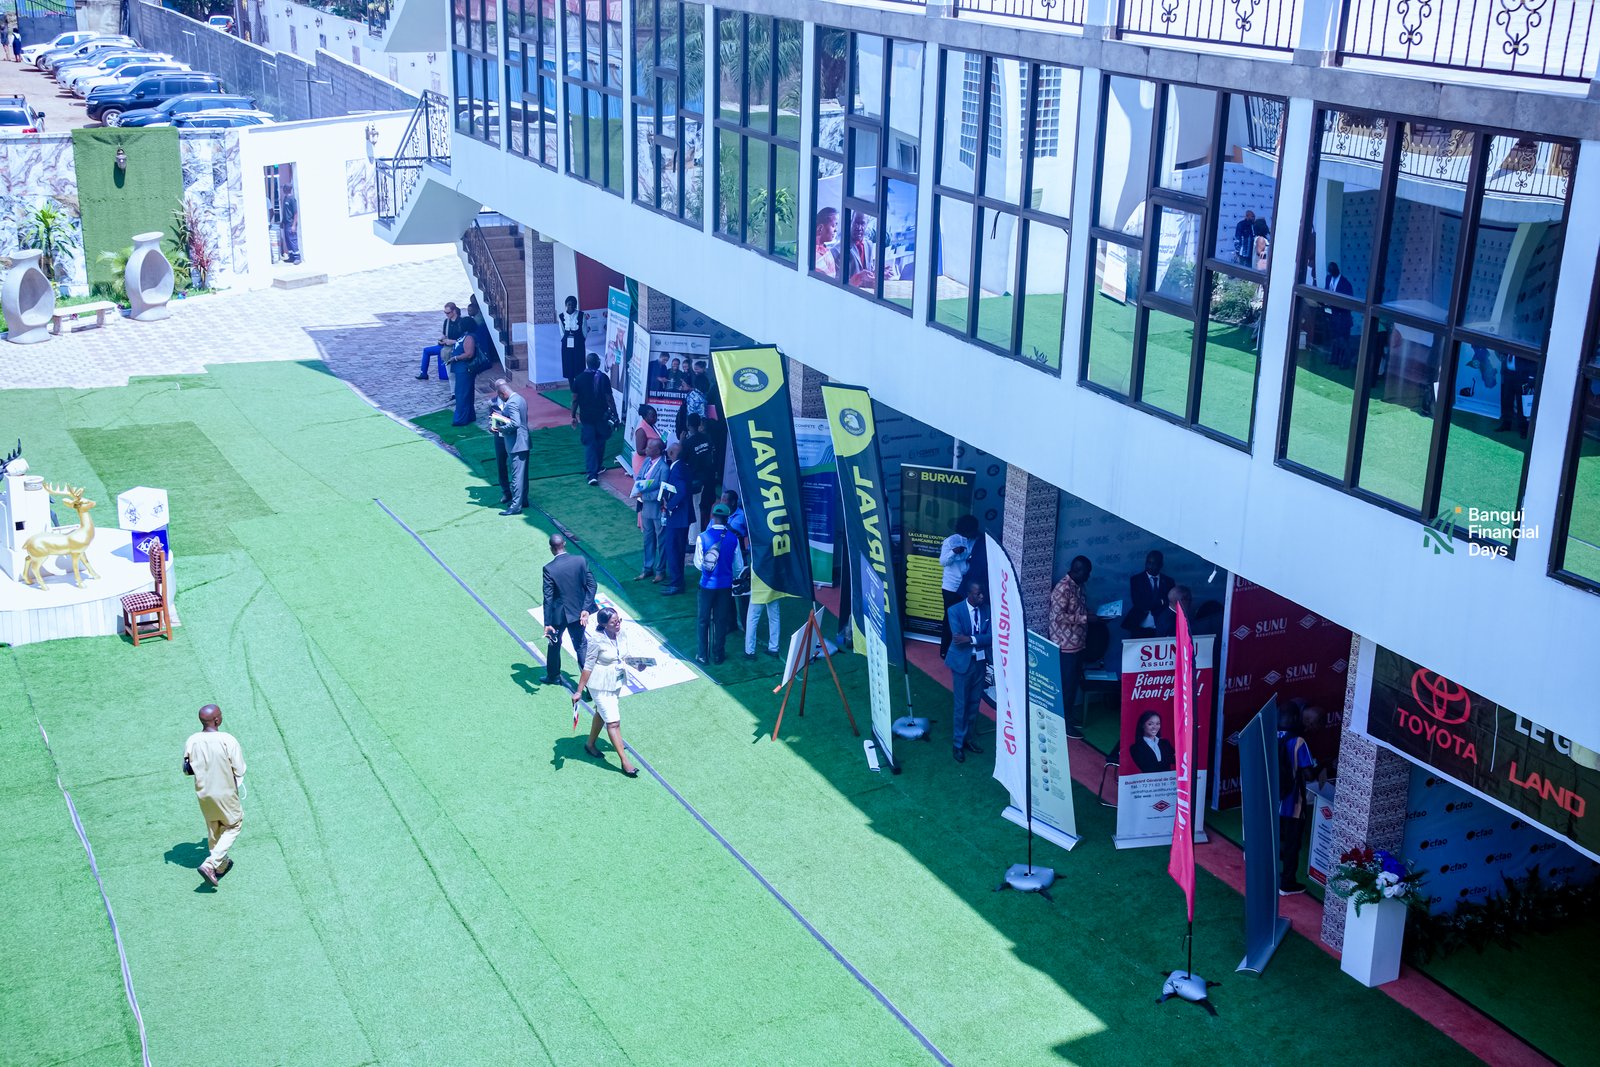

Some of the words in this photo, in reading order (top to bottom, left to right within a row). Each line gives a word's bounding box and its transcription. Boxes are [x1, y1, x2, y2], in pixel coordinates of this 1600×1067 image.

[920, 471, 968, 486] BURVAL
[1255, 617, 1288, 635] SUNU
[1141, 660, 1174, 668] Assura
[1285, 662, 1318, 679] SUNU
[1131, 686, 1163, 701] Nzoni
[1397, 707, 1478, 765] TOYOTA
[1508, 760, 1586, 819] LAND
[1455, 801, 1473, 811] cfao
[1409, 810, 1427, 819] cfao
[1475, 828, 1493, 838] cfao
[1429, 838, 1447, 848] cfao
[1495, 852, 1512, 861] cfao
[1449, 862, 1468, 872] cfao
[1469, 886, 1487, 895] cfao
